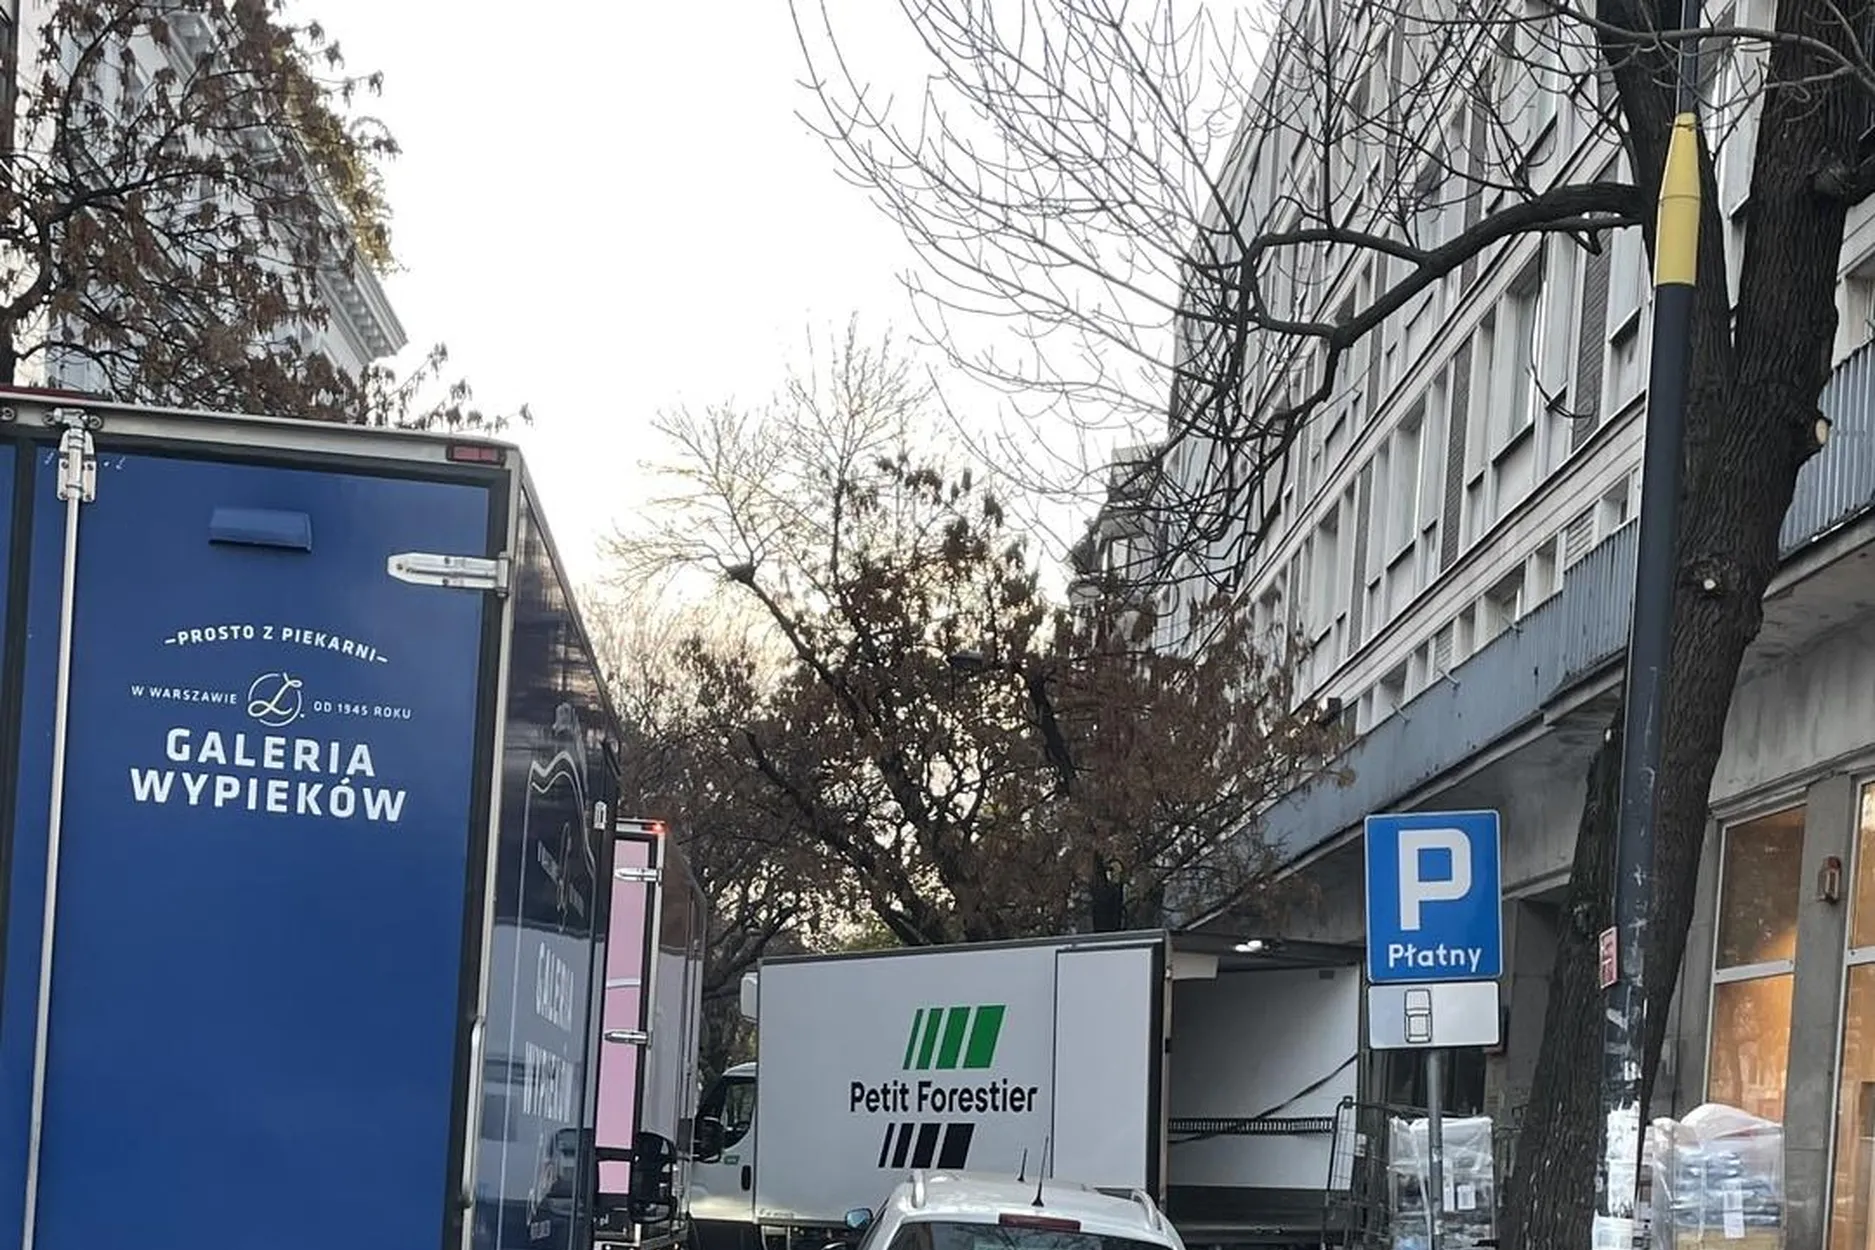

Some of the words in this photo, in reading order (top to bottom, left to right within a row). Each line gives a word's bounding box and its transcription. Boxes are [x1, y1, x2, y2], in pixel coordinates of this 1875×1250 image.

[263, 626, 274, 640] Z
[131, 685, 145, 697] W
[150, 687, 238, 705] WARSZAWIE
[313, 701, 332, 713] OD
[337, 703, 368, 717] 1945
[373, 705, 412, 720] ROKU
[165, 727, 376, 778] GALERIA
[130, 768, 407, 823] WYPIEKÓW
[1397, 828, 1472, 931] P
[1388, 943, 1482, 973] Płatny
[850, 1079, 910, 1113] Petit
[917, 1078, 1038, 1114] Forestier
